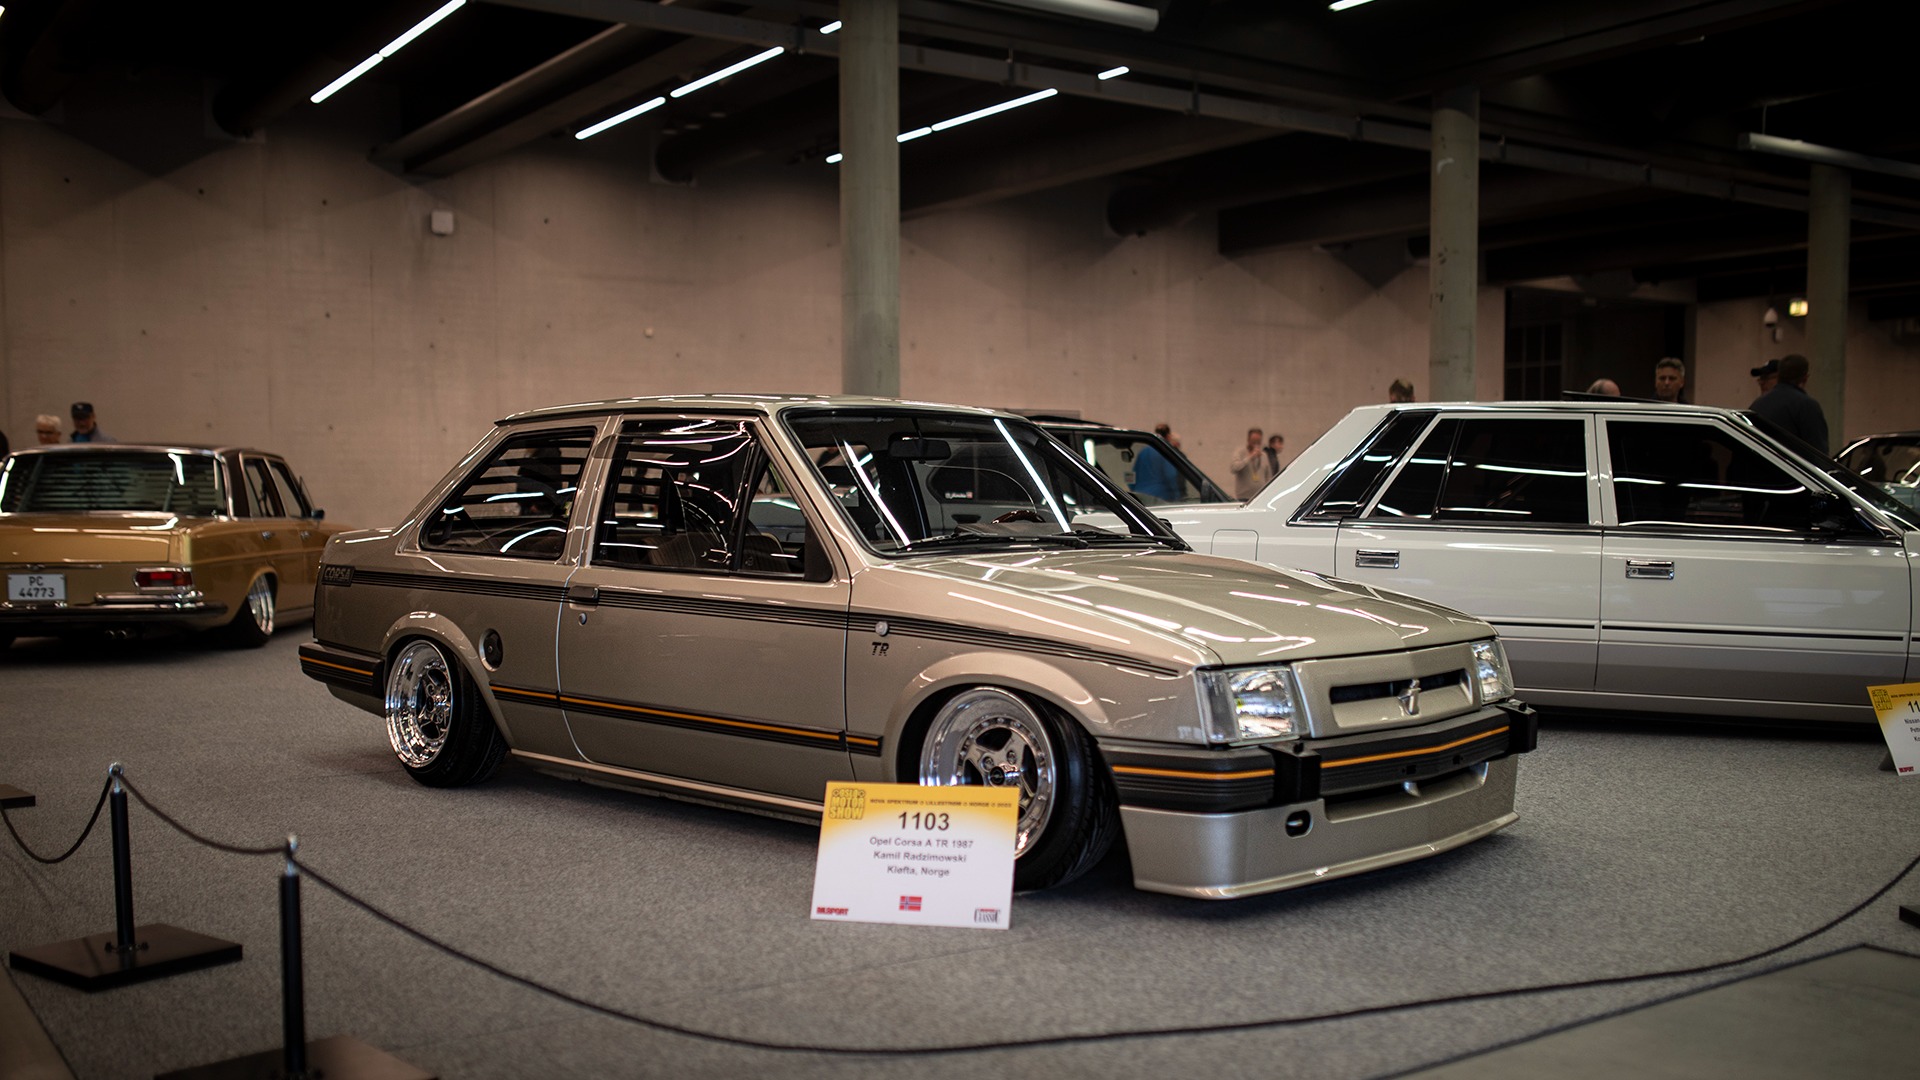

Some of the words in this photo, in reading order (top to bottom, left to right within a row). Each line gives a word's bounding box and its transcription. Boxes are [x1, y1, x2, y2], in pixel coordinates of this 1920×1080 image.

[28, 575, 44, 587] PC
[18, 587, 55, 598] 44773
[871, 641, 890, 657] TR
[831, 796, 865, 809] MOTOR
[828, 806, 864, 820] SHOW
[898, 811, 950, 831] 1103
[869, 837, 892, 847] Opel
[894, 837, 922, 847] Corsa
[925, 838, 933, 848] A
[936, 839, 949, 848] TR
[952, 839, 974, 849] 1987
[873, 851, 900, 860] Kamil
[903, 851, 967, 863] Radzimowski
[920, 867, 950, 878] Norge
